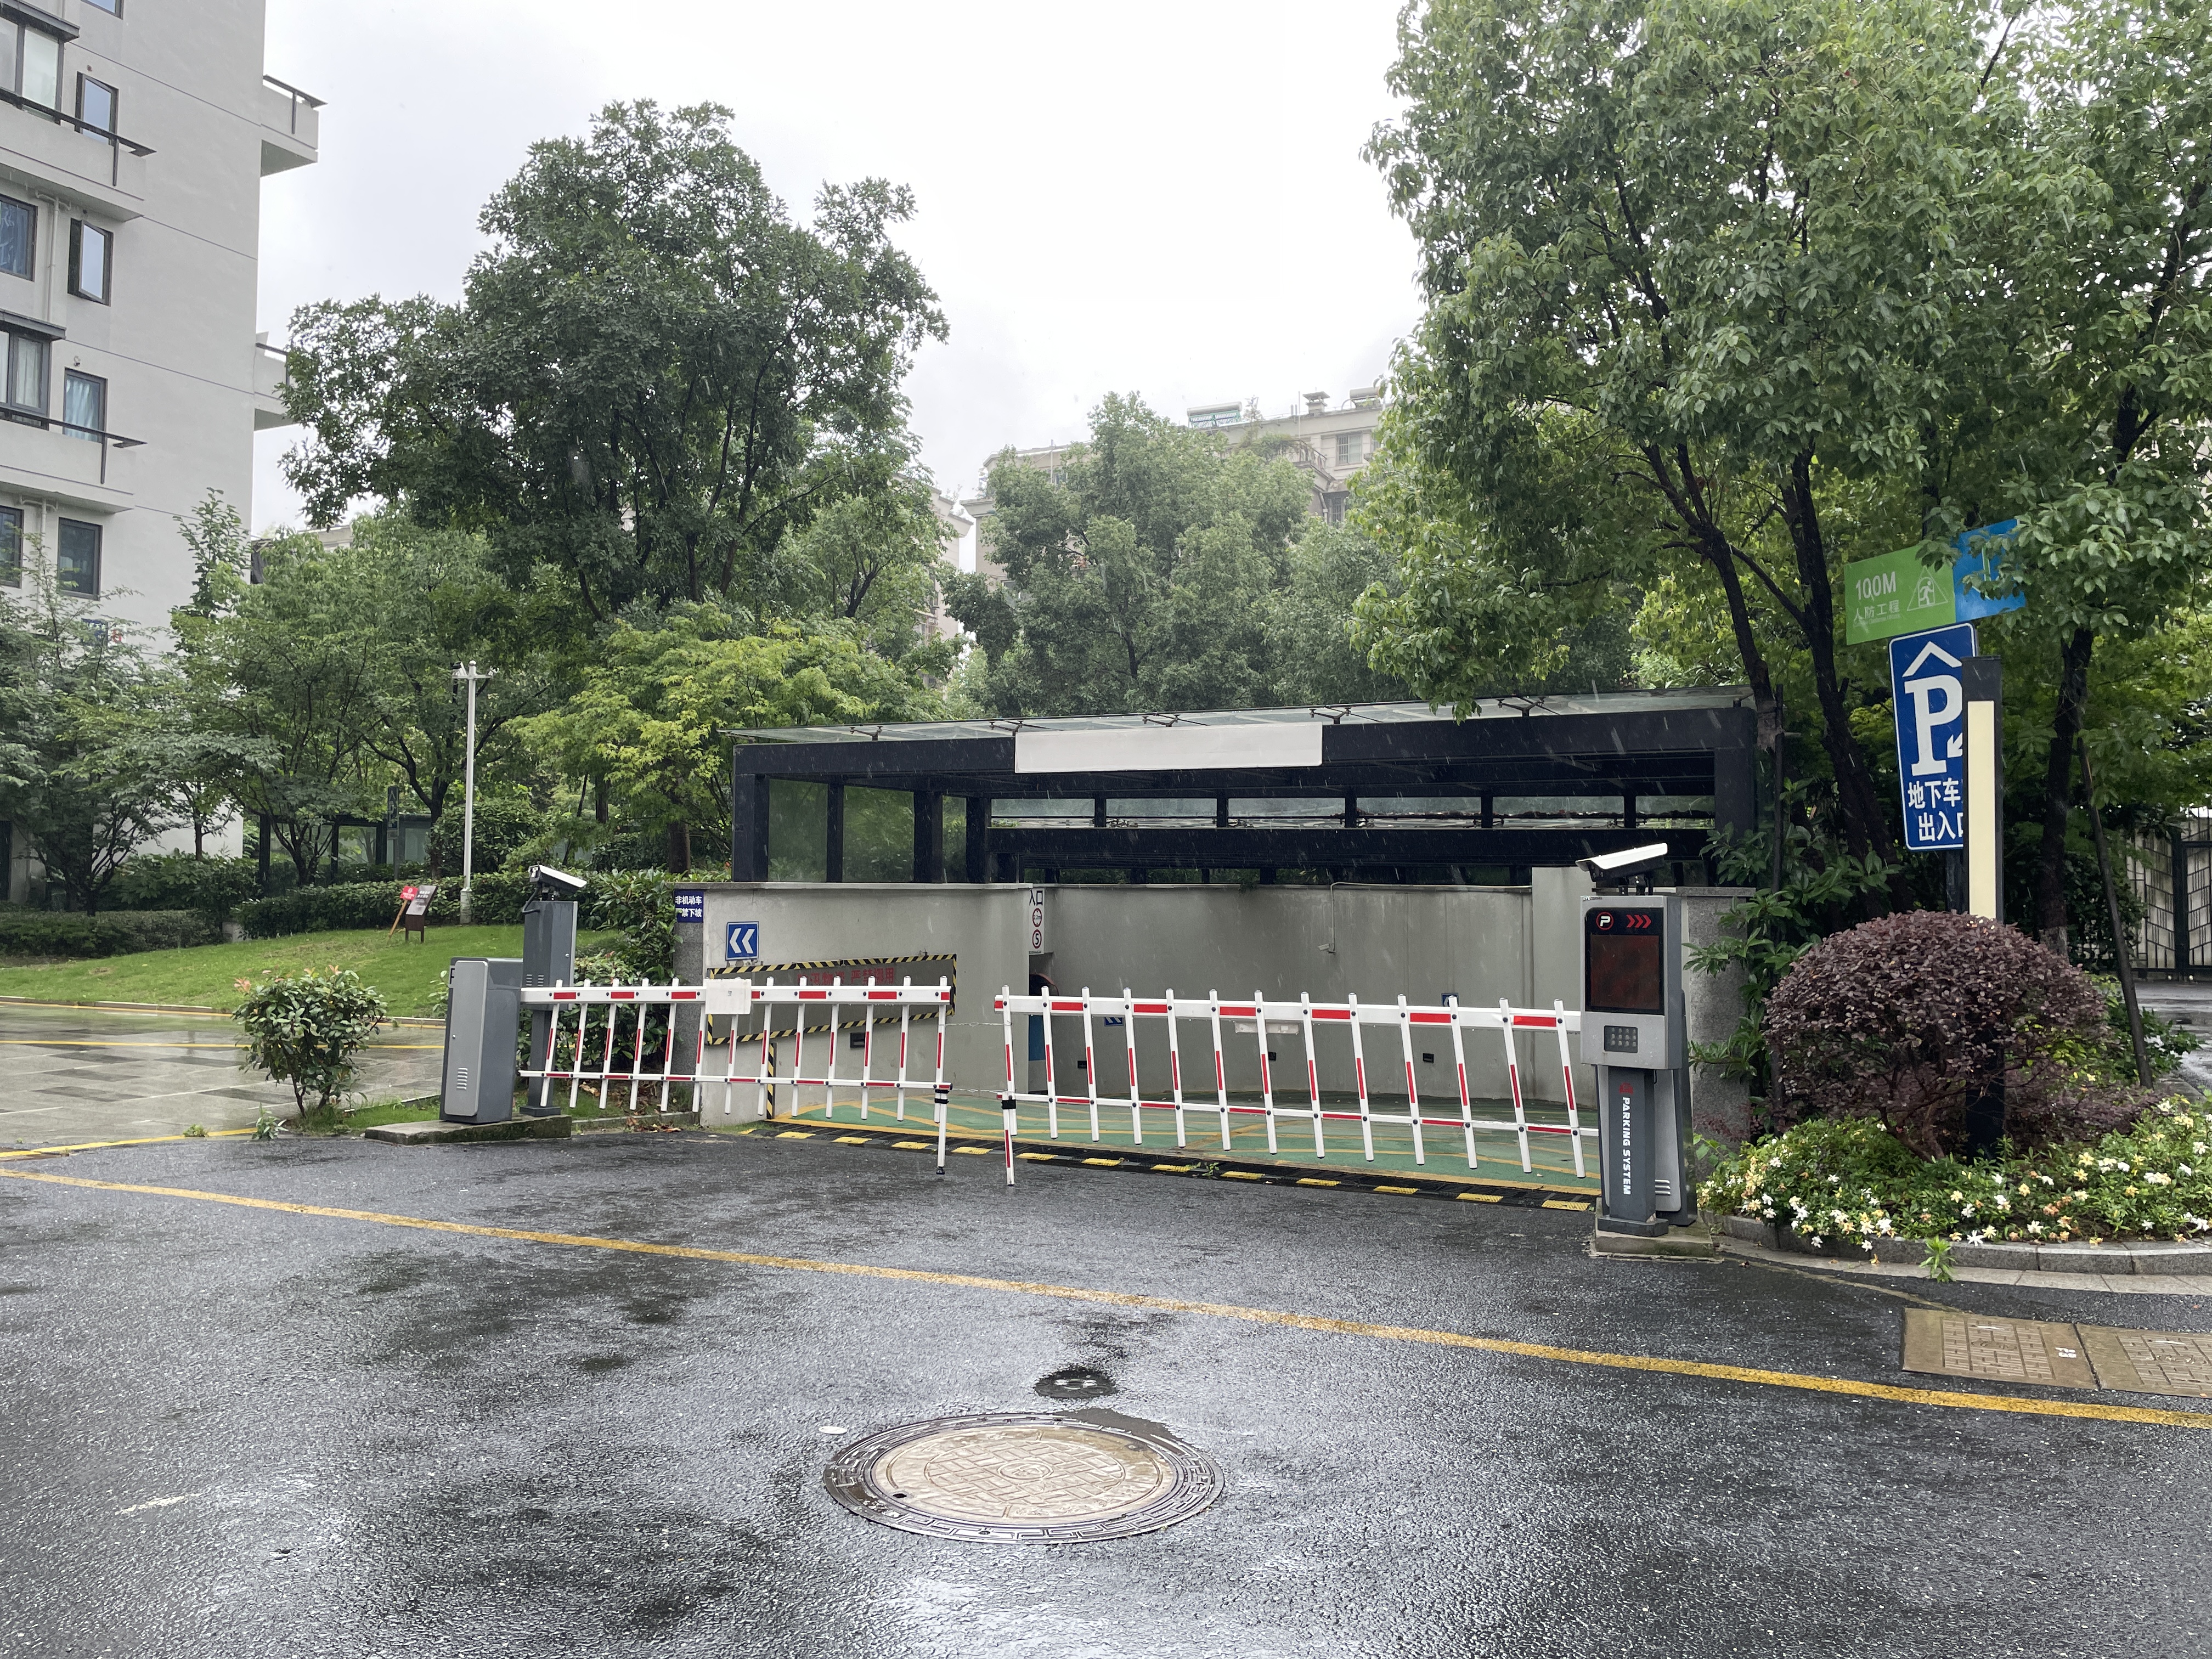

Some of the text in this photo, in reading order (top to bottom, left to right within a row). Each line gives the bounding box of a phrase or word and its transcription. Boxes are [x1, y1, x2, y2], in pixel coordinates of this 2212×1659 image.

[1855, 571, 1897, 600] 100M
[1853, 599, 1900, 622] 人防工程
[1904, 674, 1962, 776] P
[1908, 777, 1963, 809] 地下车
[675, 895, 702, 905] 非机动车
[1029, 889, 1043, 906] 入口
[1600, 916, 1611, 927] P
[1035, 933, 1039, 945] 5
[1622, 1097, 1631, 1195] PARKING SYSTEM
